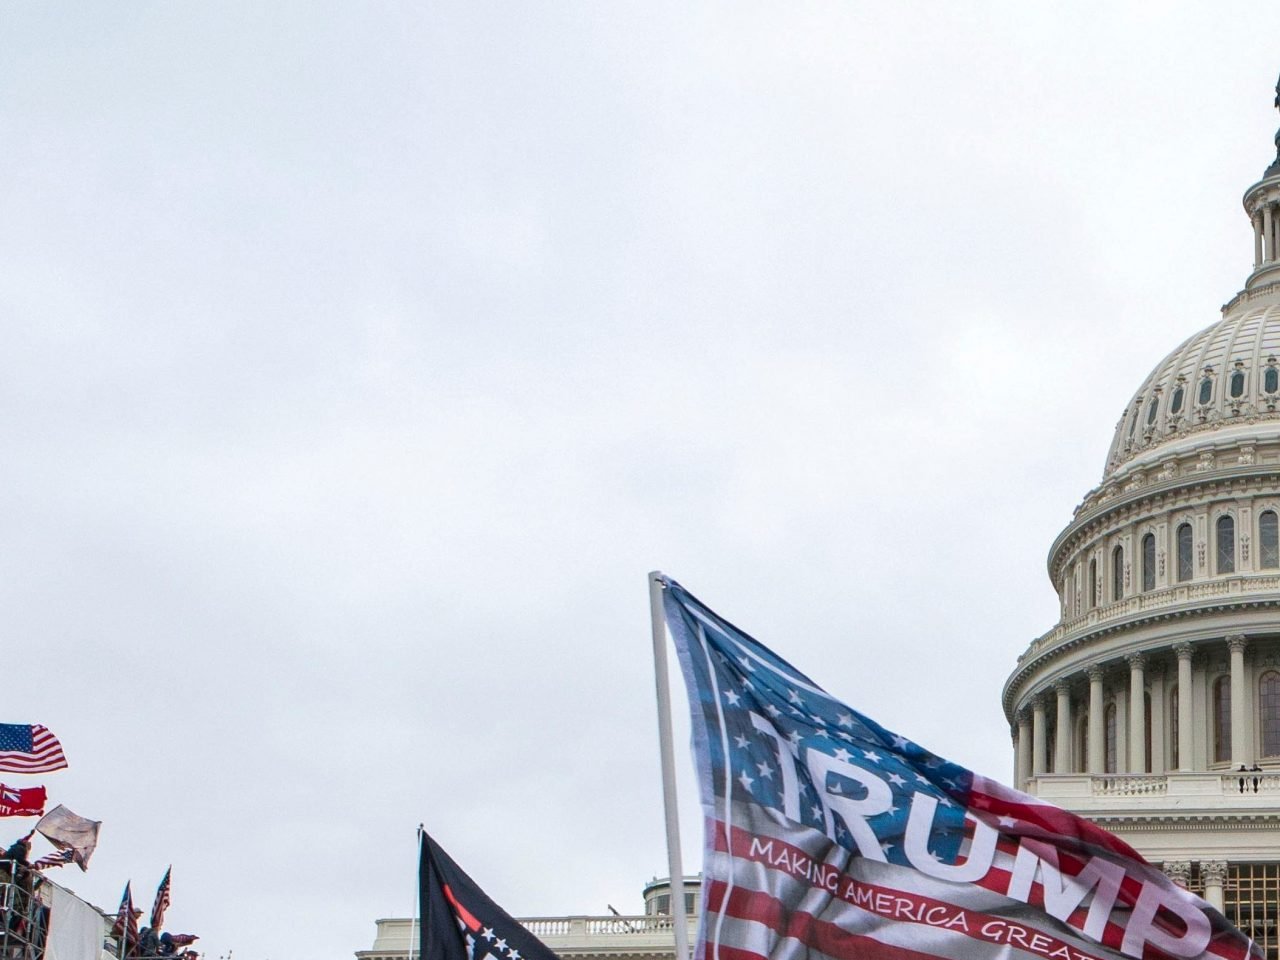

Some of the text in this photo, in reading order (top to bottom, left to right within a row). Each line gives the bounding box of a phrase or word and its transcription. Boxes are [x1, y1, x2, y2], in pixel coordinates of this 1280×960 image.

[749, 837, 838, 895] MAKING
[845, 885, 969, 932] AMERICA
[750, 711, 1212, 959] TRUMP
